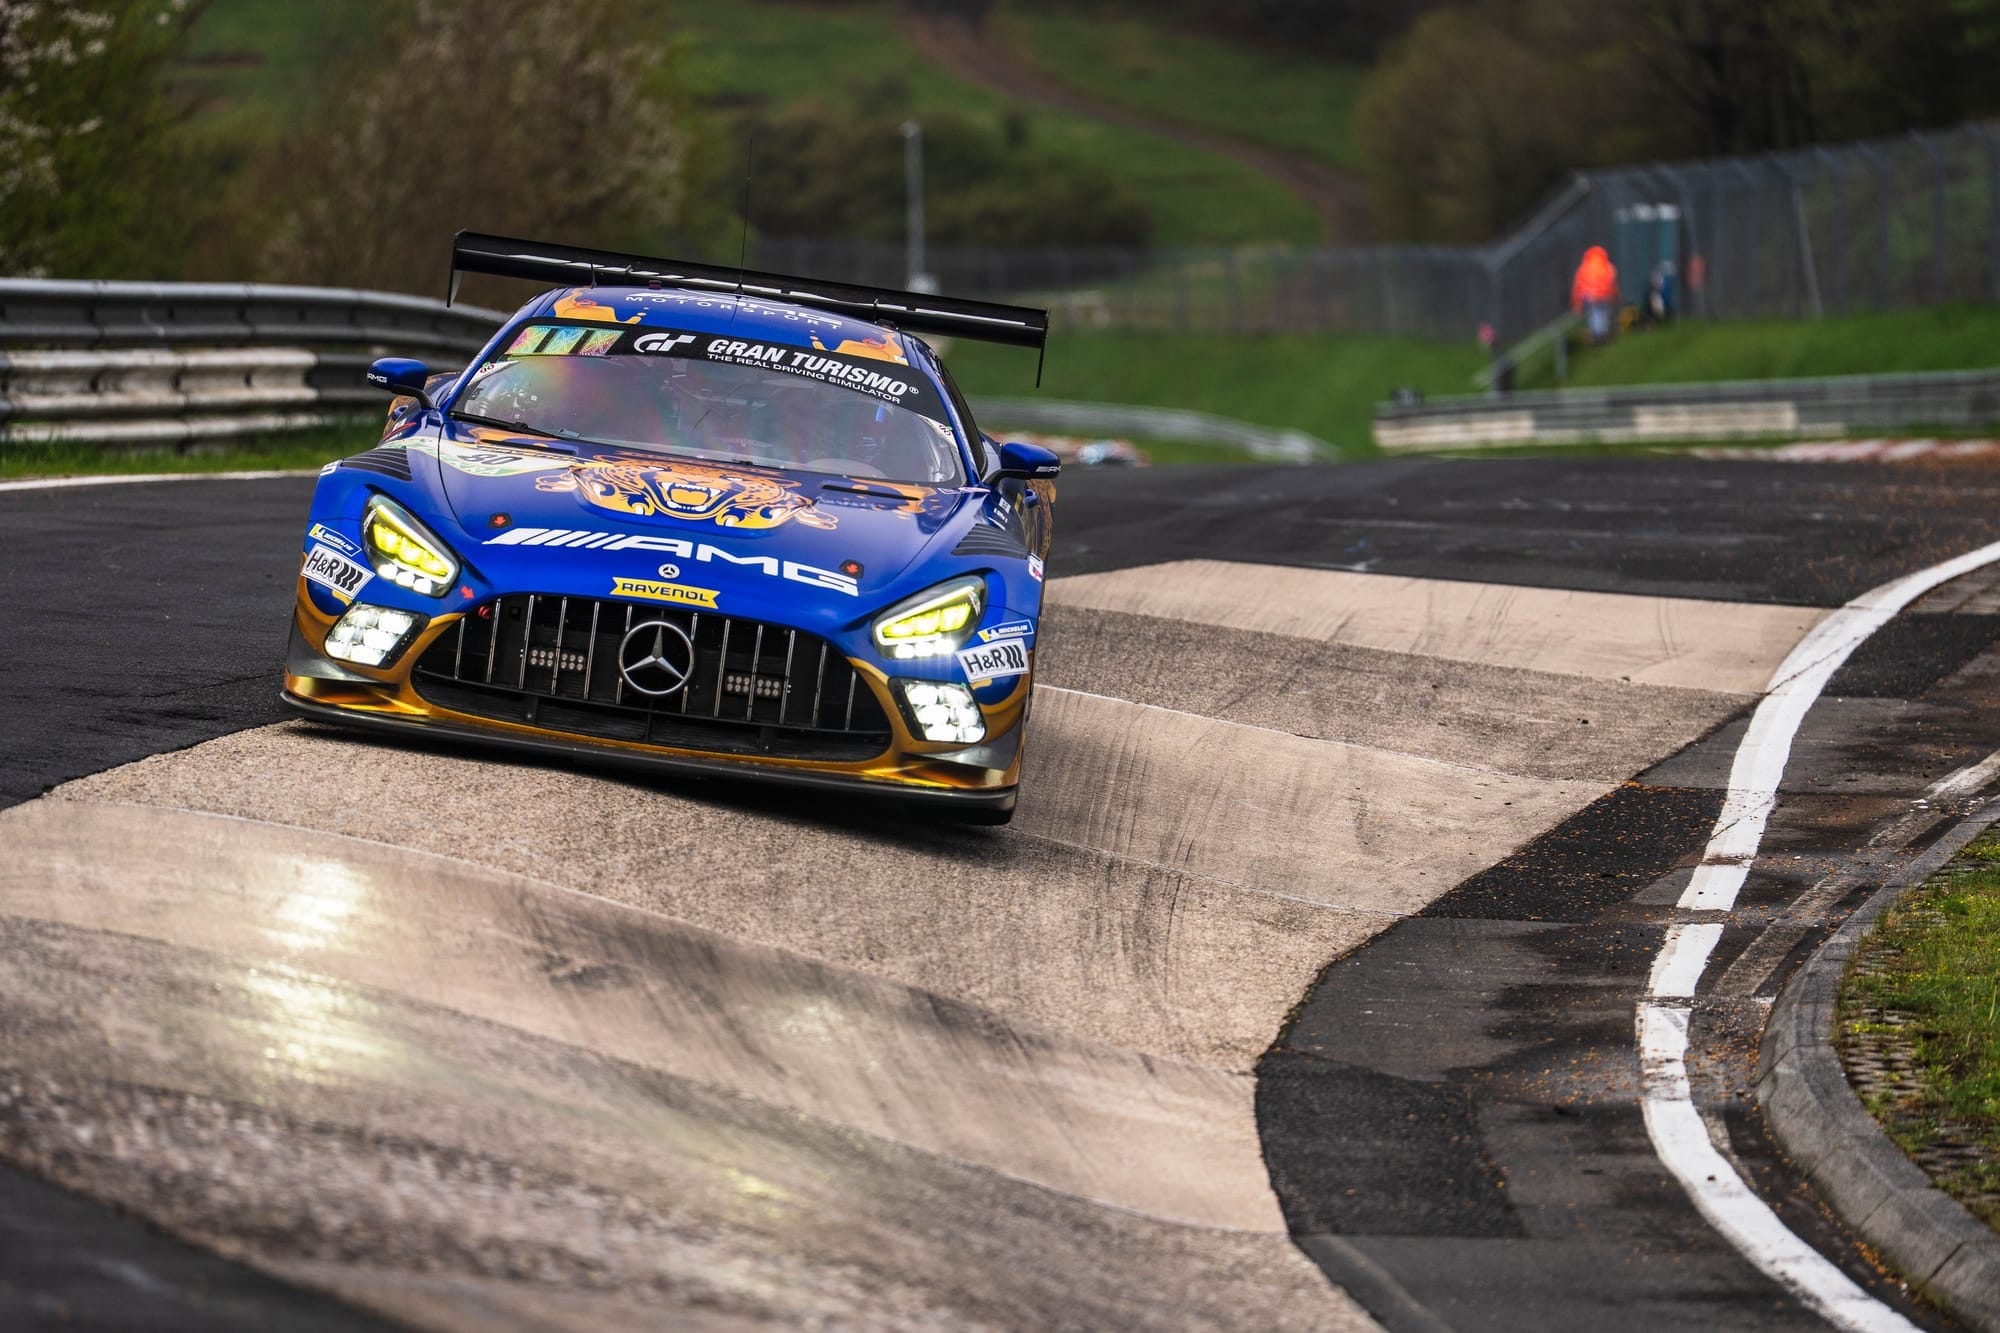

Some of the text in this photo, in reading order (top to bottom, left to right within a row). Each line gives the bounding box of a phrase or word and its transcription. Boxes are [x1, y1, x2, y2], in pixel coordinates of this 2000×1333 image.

[626, 296, 840, 329] MOTORSPORT
[707, 339, 786, 363] GRAN
[707, 353, 901, 404] THE REAL DRIVING SIMULATOR
[600, 534, 858, 597] AMG
[621, 582, 710, 602] RAVENOL
[963, 648, 1006, 673] H&R
